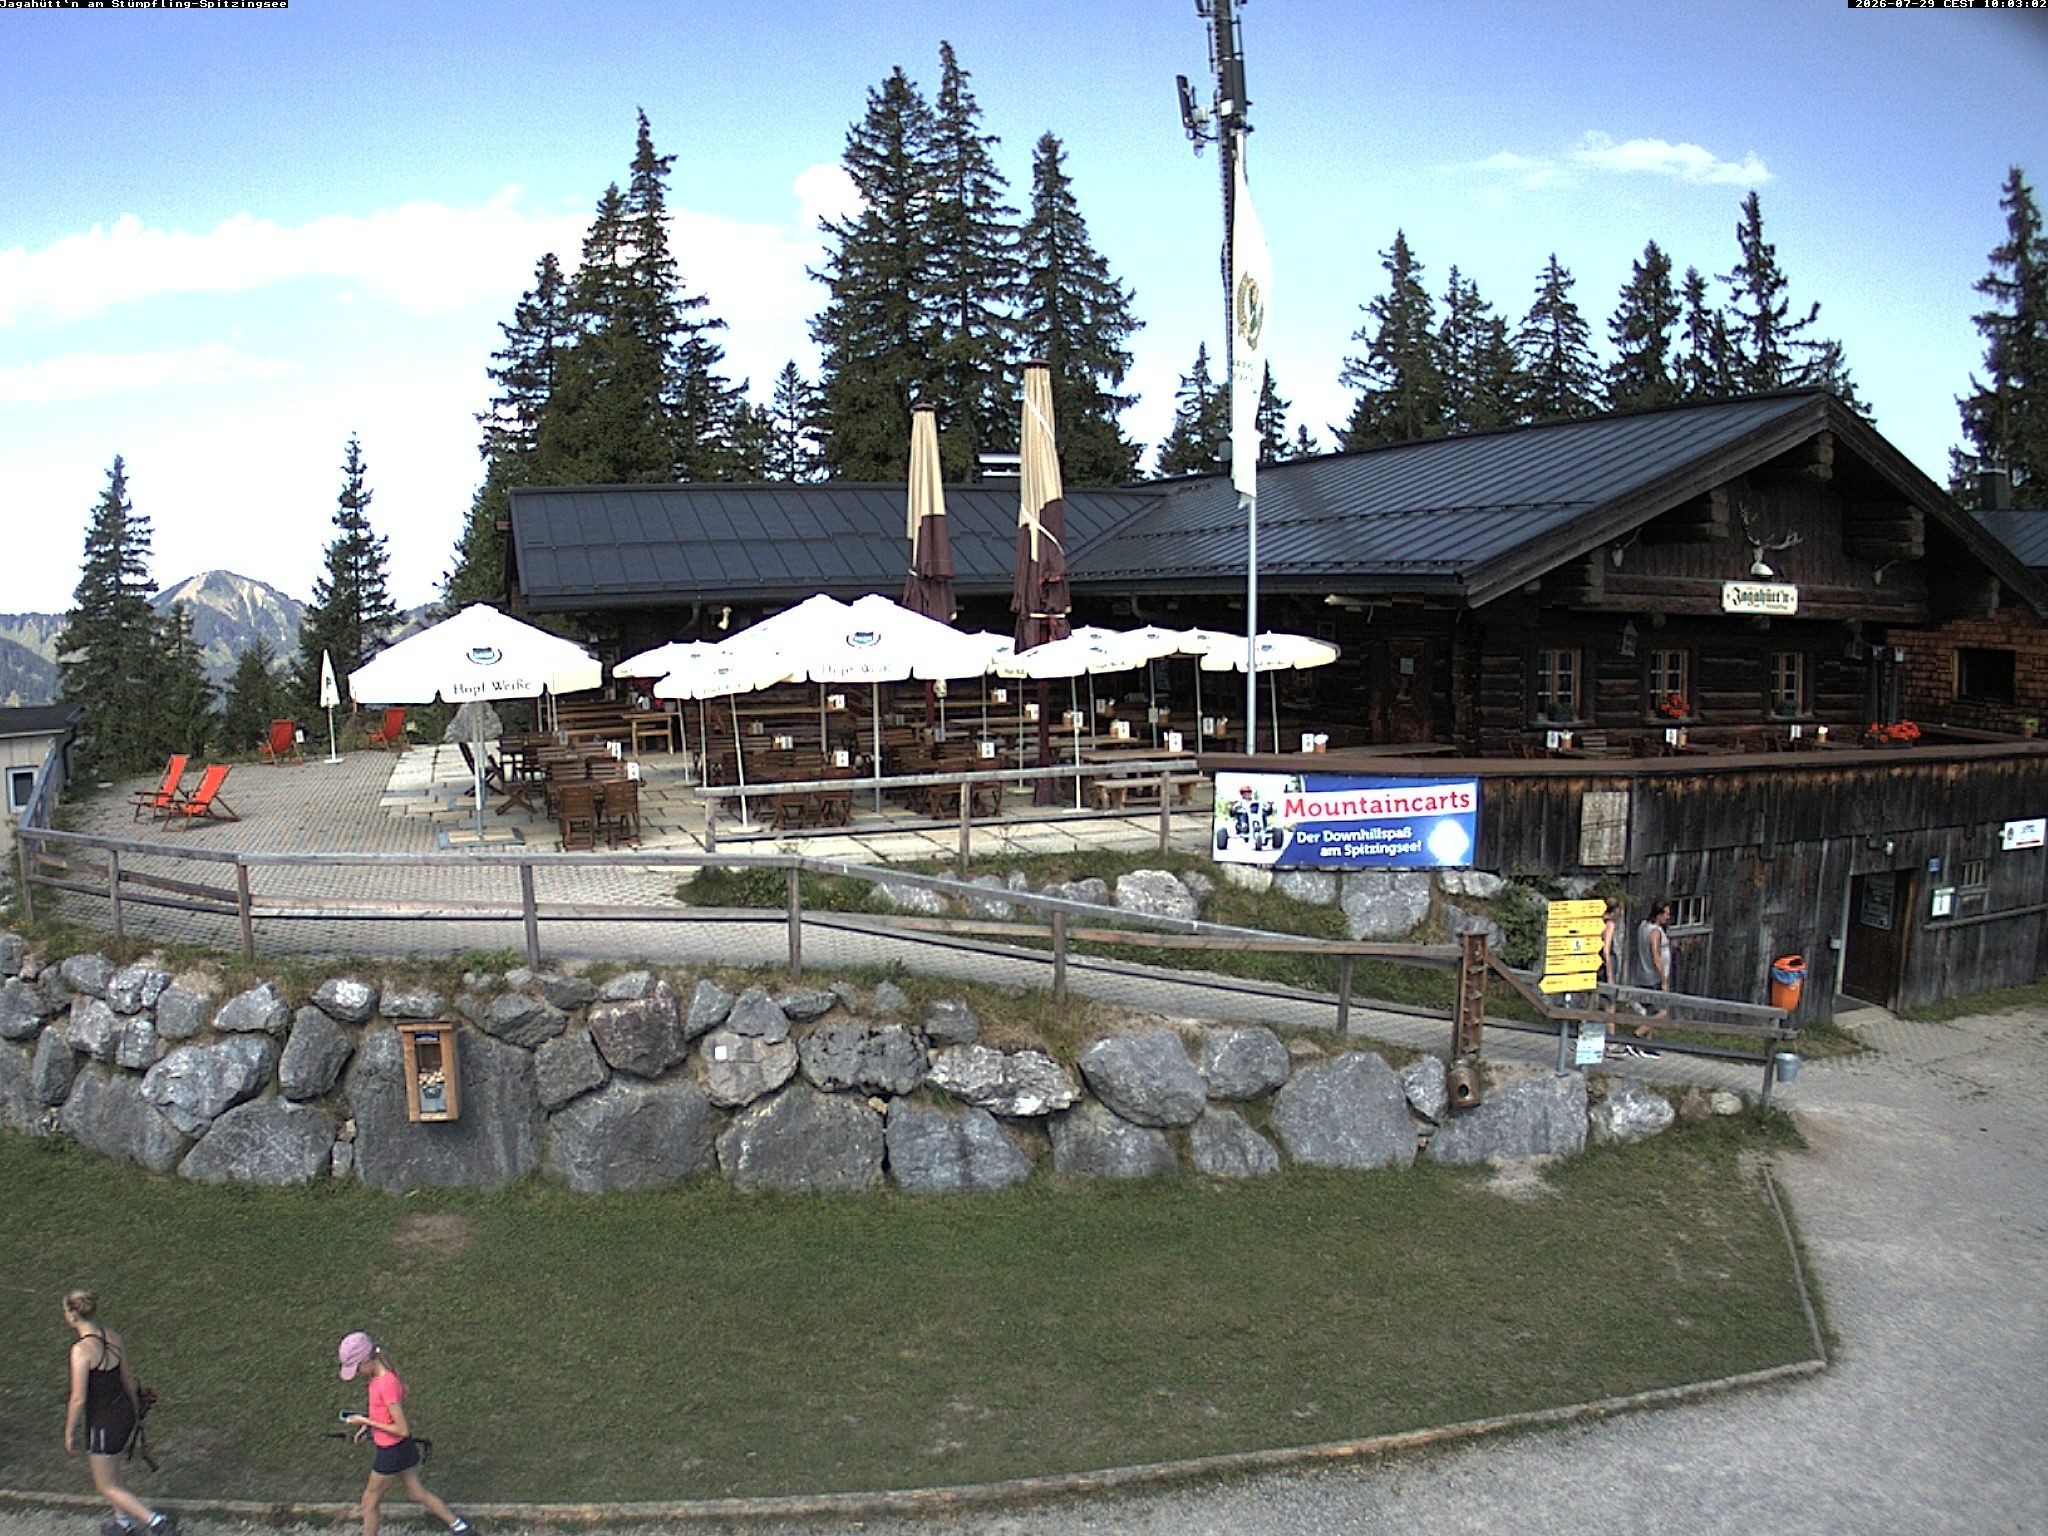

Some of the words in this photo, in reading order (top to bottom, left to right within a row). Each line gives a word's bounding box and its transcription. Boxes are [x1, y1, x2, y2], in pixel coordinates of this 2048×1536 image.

[1284, 790, 1470, 818] Mountaincarts
[1296, 830, 1321, 844] Der
[1322, 826, 1413, 845] Downhillspaß
[1319, 846, 1342, 858] am
[1344, 839, 1422, 858] Spitzingsee!
